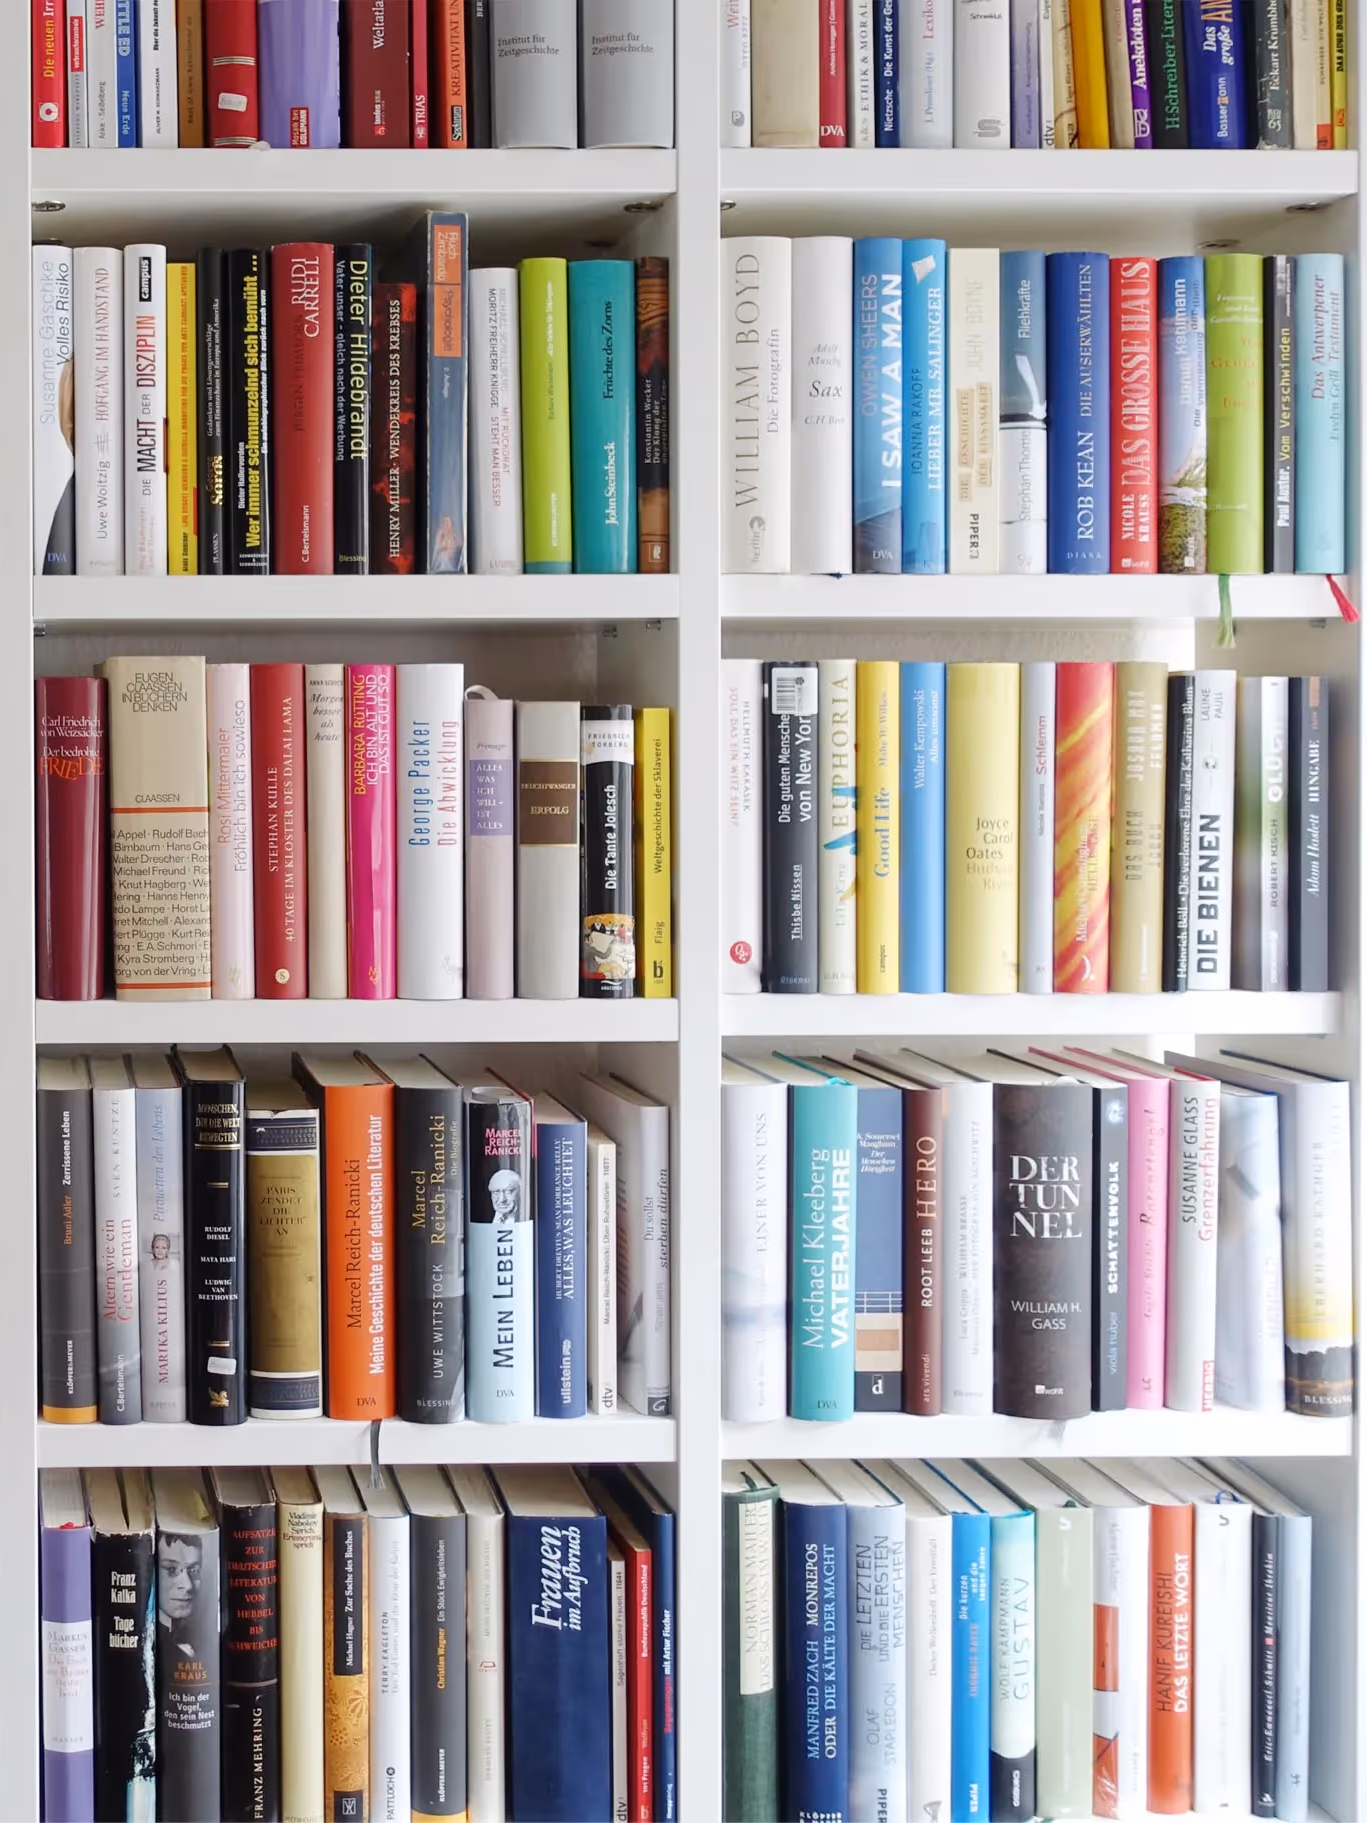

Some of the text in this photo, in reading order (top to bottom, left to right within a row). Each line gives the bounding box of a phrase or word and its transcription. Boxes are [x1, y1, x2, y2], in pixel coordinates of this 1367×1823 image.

[43, 20, 55, 77] Die neuen
[498, 33, 546, 47] Institut für
[498, 45, 560, 58] Zeitgeschichte
[883, 18, 893, 131] Nietzsche Die Kunst der
[1131, 8, 1148, 90] Anekdoten
[415, 95, 426, 124] TRIAS
[821, 125, 845, 136] DVA
[55, 263, 71, 365] Volles Risiko
[291, 258, 306, 304] RUDI
[304, 256, 320, 337] CARRELL
[349, 260, 368, 460] Dieter Hildebrandt
[734, 253, 760, 508] WILLIAM BOYD
[1120, 262, 1151, 485] DAS GROSSE HAUS
[1279, 328, 1291, 428] Verschwinden
[1077, 431, 1095, 540] ROB KEAN
[1280, 435, 1291, 461] Vom
[300, 505, 310, 563] C.Bertelsmann
[1276, 504, 1290, 527] Paul
[126, 682, 183, 693] CLAASSEN
[132, 703, 178, 712] DENKEN
[134, 673, 174, 683] EUGEN
[407, 720, 433, 846] George Packer
[603, 784, 617, 889] Die Tante Jolesch
[790, 865, 802, 940] Thisbe Nissen
[1197, 813, 1220, 974] DIE BIENEN
[60, 1111, 72, 1185] Zerrissene Leben
[1010, 1155, 1081, 1182] DER
[1181, 1097, 1199, 1223] SUSANNE GLASS
[343, 1159, 361, 1329] Marcel Reich-Ranicki
[831, 1149, 851, 1349] VATERJAHRE
[916, 1136, 938, 1307] ROOT LEEB HERO
[493, 1229, 515, 1369] MEIN LEBEN
[531, 1525, 563, 1630] Frauen
[562, 1526, 588, 1631] im Aufbruch
[805, 1543, 820, 1759] MANFRED ZACH MONREPOS
[1175, 1553, 1189, 1713] DAS LETZTE WORT
[253, 1707, 263, 1819] FRANZ MEHRING
